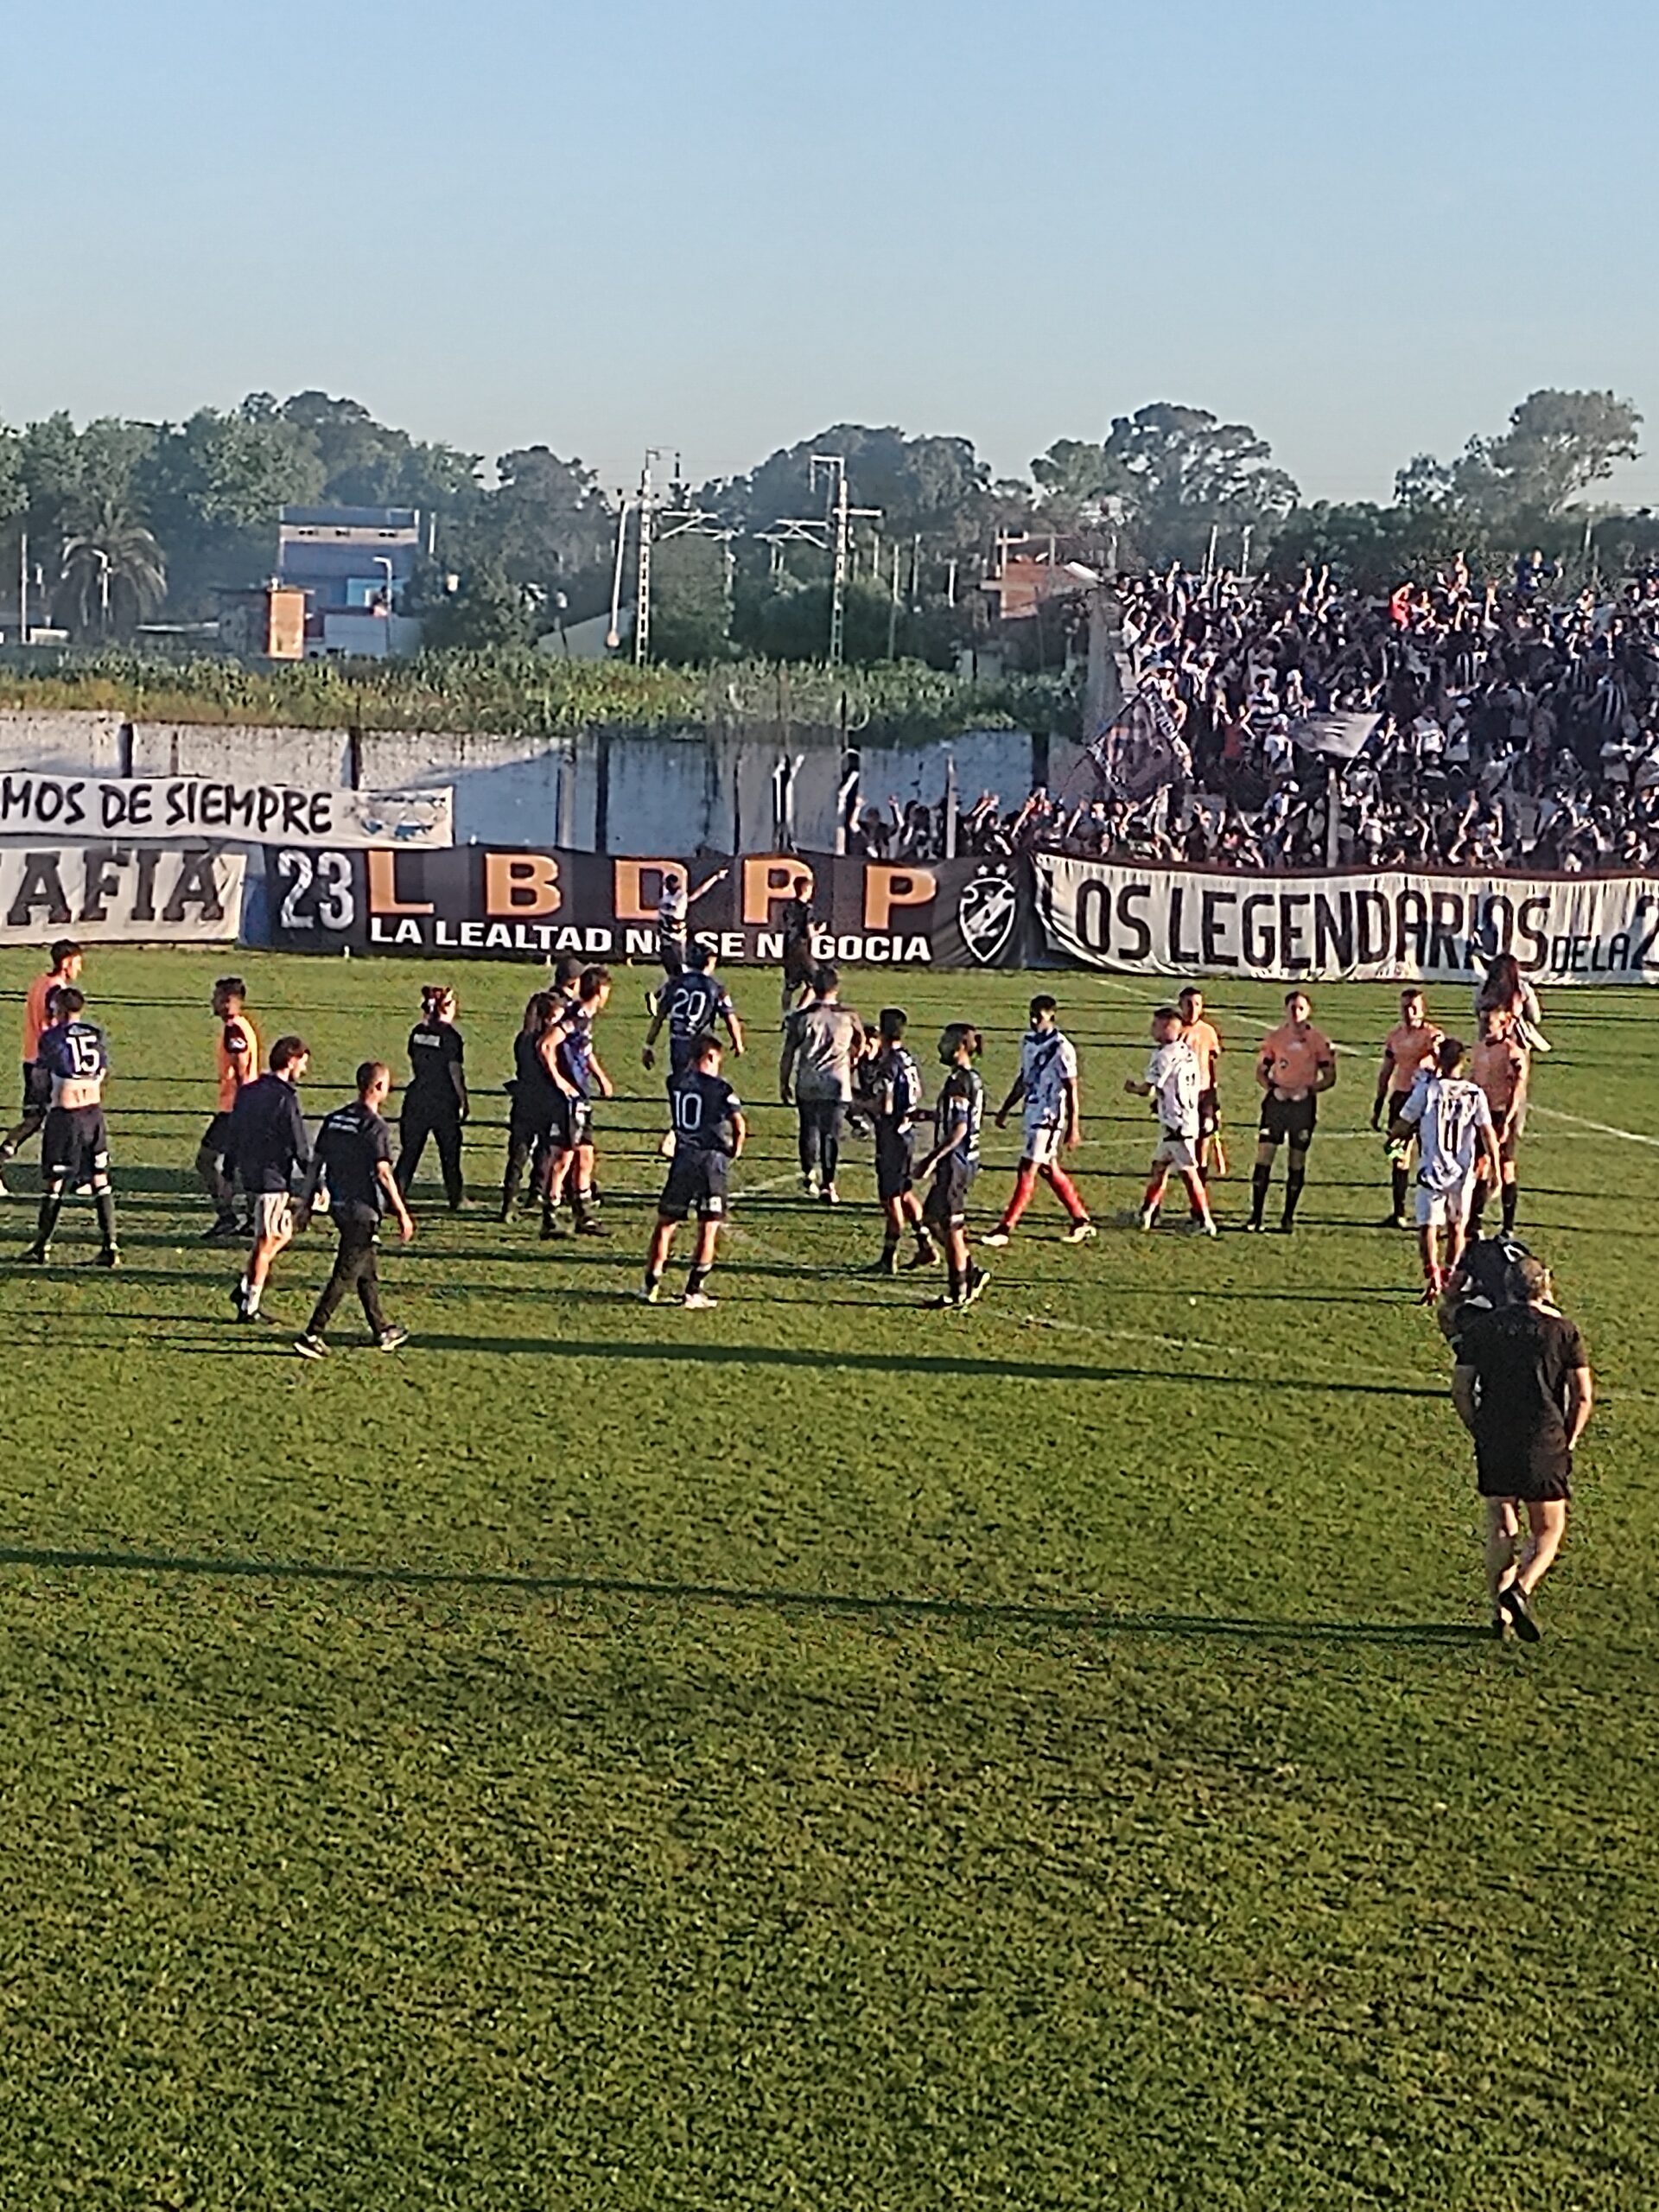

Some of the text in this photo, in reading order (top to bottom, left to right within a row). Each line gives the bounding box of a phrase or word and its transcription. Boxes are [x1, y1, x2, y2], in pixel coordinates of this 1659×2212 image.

[2, 777, 333, 836] MOS DE SIEMPRE
[278, 849, 354, 930] 23
[368, 850, 434, 913] L
[486, 853, 561, 915] B
[744, 859, 813, 924] P
[865, 866, 936, 929] P
[371, 918, 423, 944] LA
[435, 920, 612, 951] LEALTAD
[625, 928, 660, 954] N
[757, 932, 931, 962] NGOCIA
[1169, 887, 1552, 971] LEGENDARIOS
[671, 988, 706, 1022] 20
[67, 1036, 101, 1073] 15
[673, 1090, 702, 1130] 10
